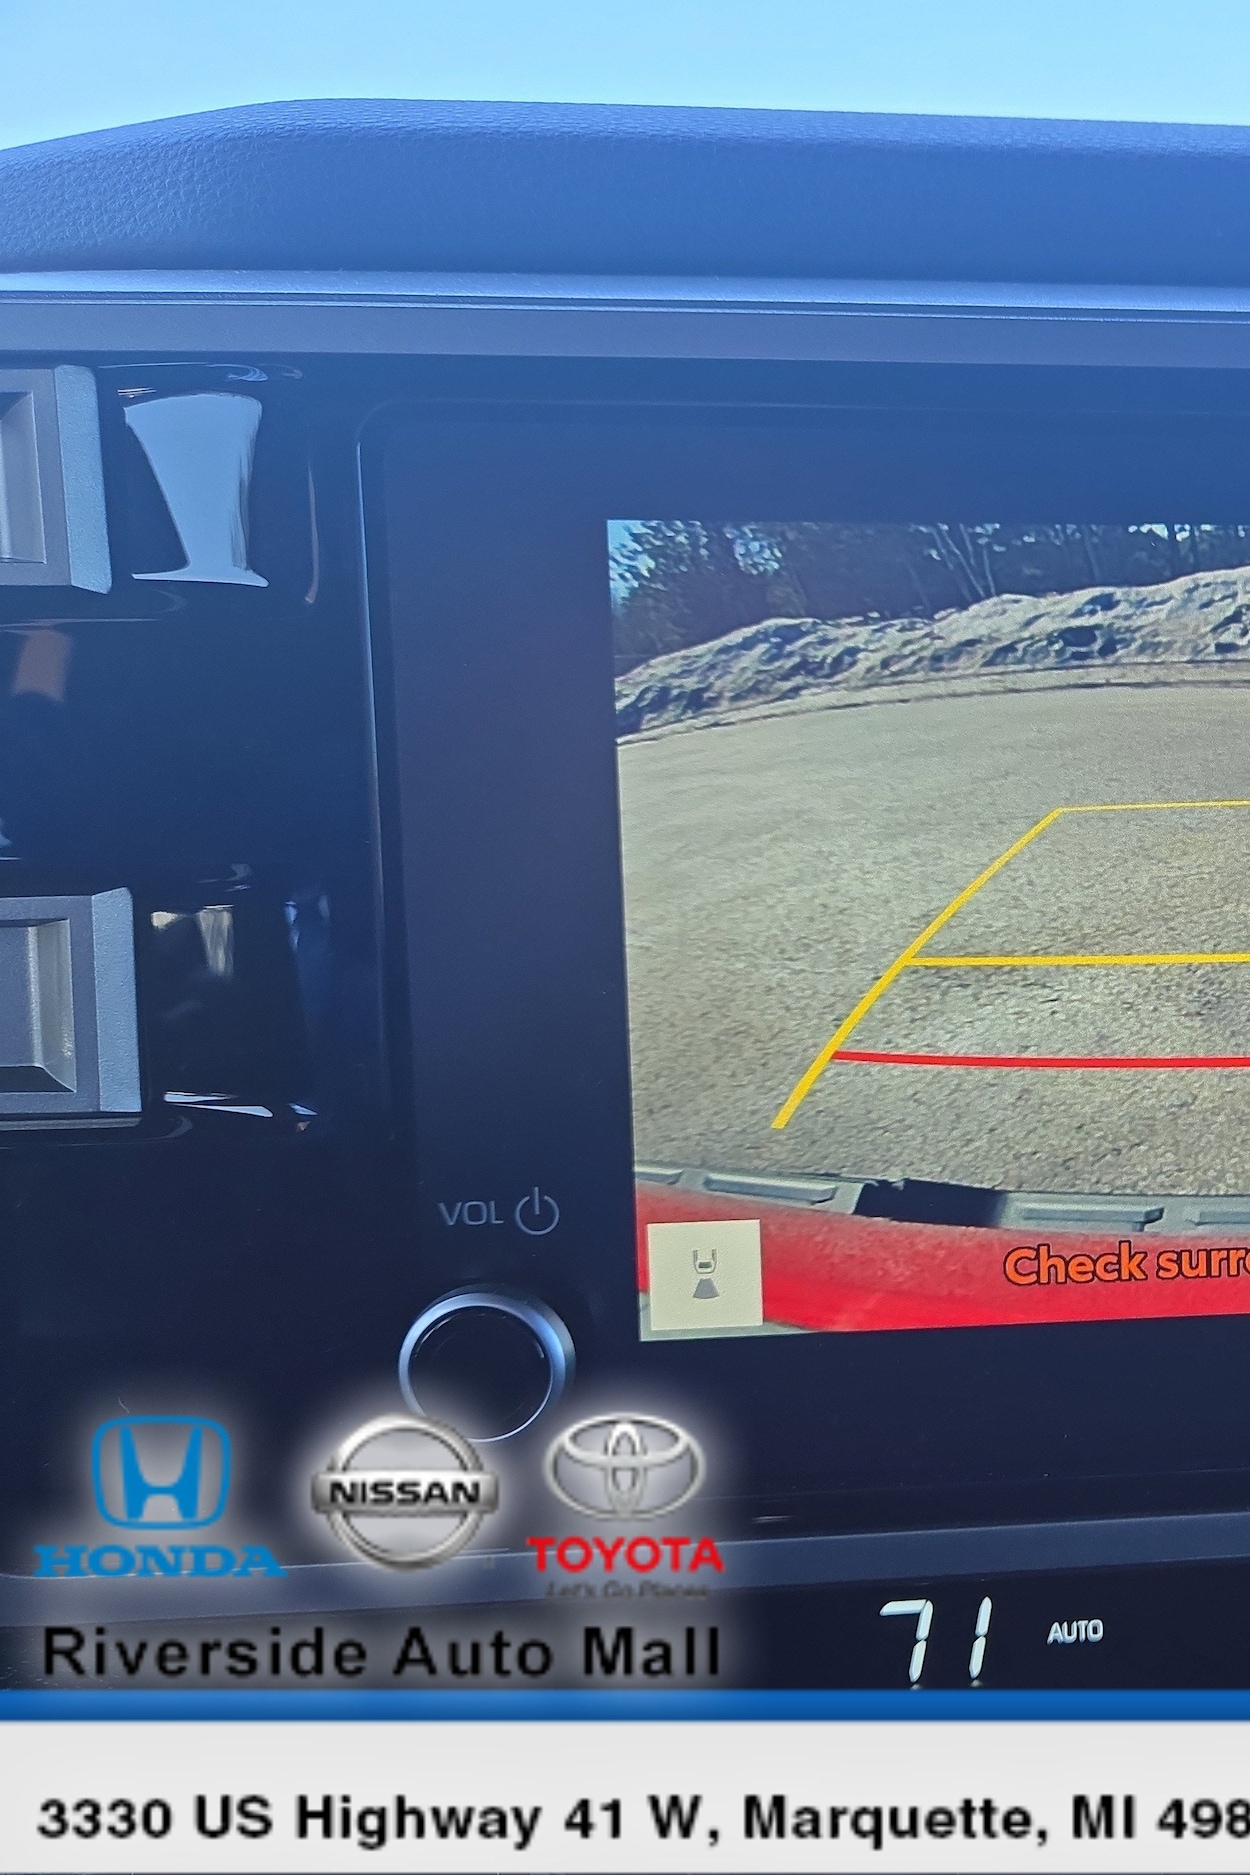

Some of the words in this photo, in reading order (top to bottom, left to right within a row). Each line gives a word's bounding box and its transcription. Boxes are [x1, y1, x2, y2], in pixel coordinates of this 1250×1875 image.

[439, 1200, 504, 1226] VOL
[1003, 1240, 1149, 1287] Check
[878, 1595, 993, 1684] 71
[1046, 1617, 1105, 1645] AUTO
